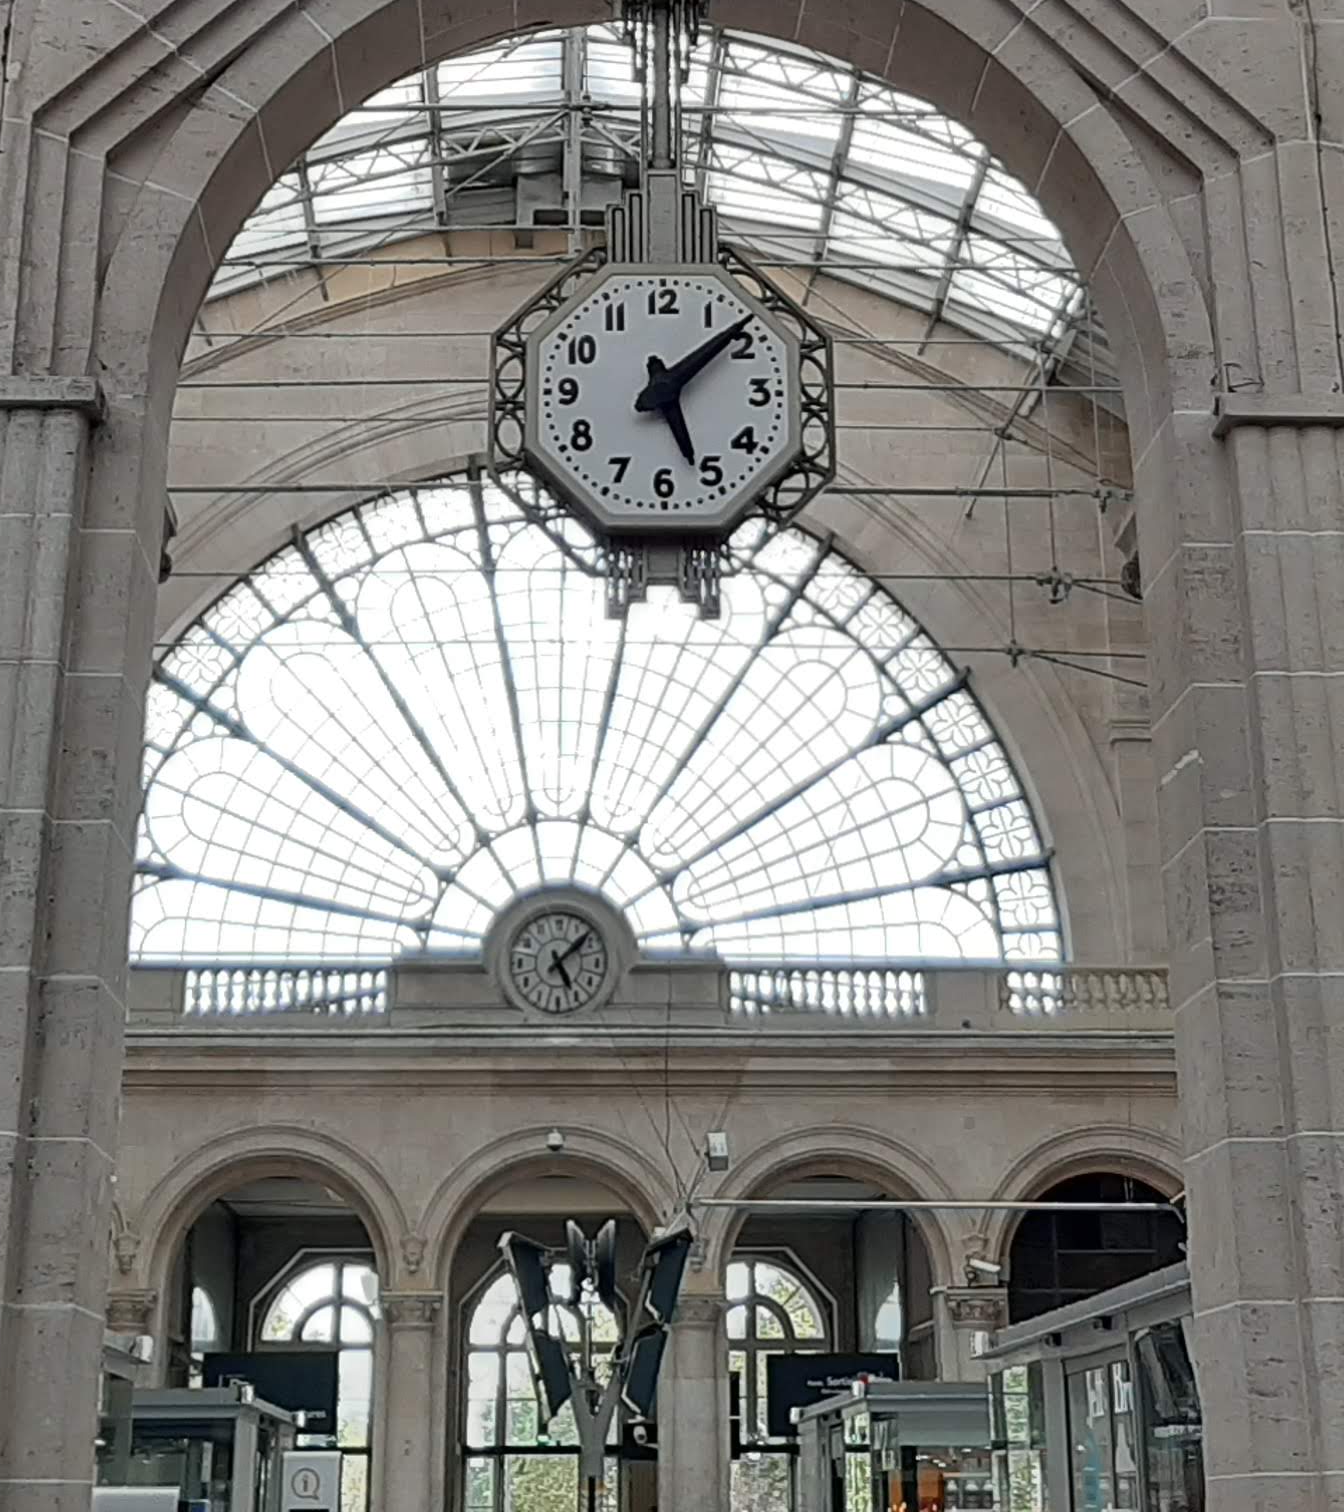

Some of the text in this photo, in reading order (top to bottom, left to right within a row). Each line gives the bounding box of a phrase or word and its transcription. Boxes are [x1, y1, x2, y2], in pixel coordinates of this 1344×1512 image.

[648, 289, 679, 315] 12
[703, 301, 712, 328] 1
[605, 302, 625, 331] 11
[567, 335, 596, 364] 10
[731, 333, 756, 360] 2
[558, 377, 579, 405] 9
[748, 378, 771, 407] 3
[570, 419, 593, 451] 8
[731, 426, 759, 454] 4
[608, 456, 631, 483] 7
[653, 468, 674, 498] 6
[699, 456, 723, 487] 5
